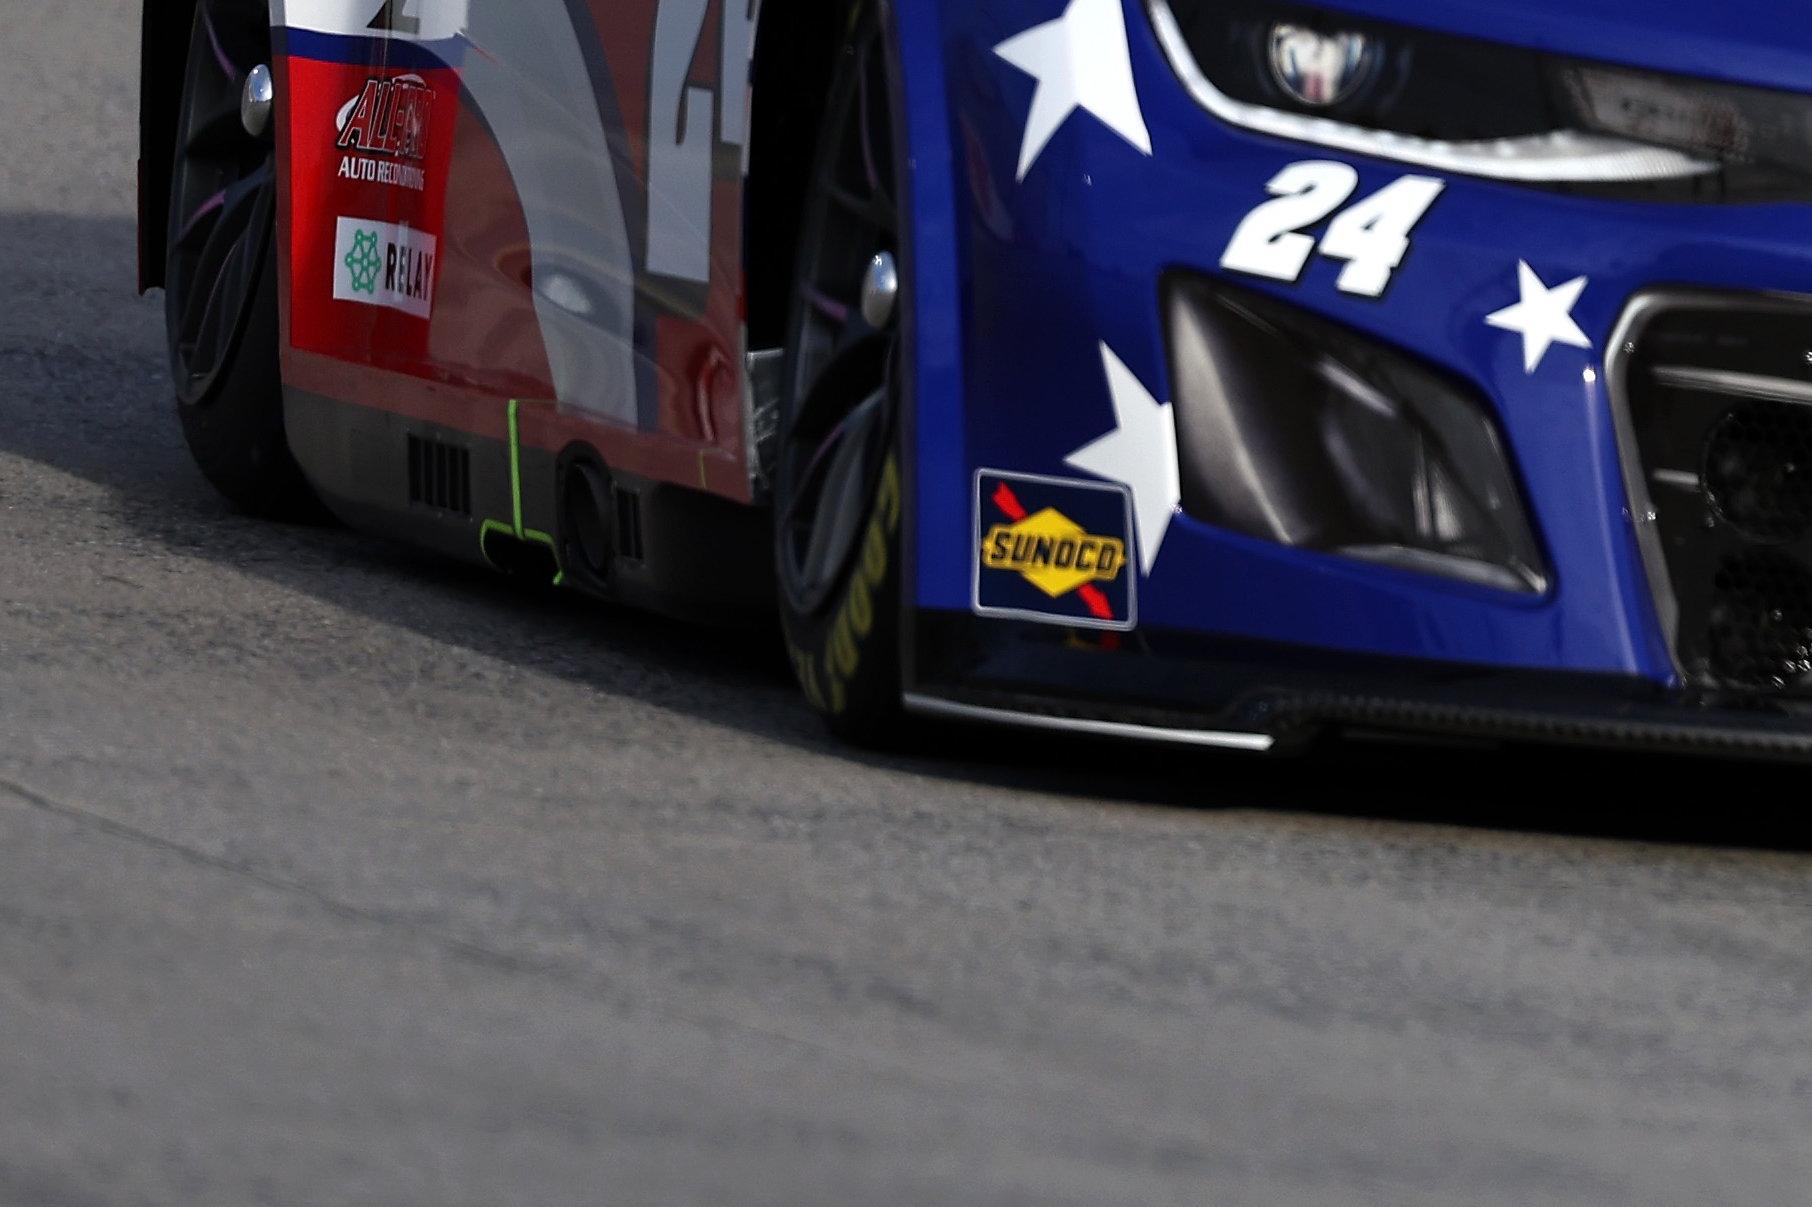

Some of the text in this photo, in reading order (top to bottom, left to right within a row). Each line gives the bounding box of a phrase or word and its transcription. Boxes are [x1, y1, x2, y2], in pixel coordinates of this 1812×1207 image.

[338, 155, 376, 181] AUTO
[1220, 159, 1446, 297] 24
[385, 242, 434, 301] RELAY
[990, 530, 1118, 573] SUNOCO
